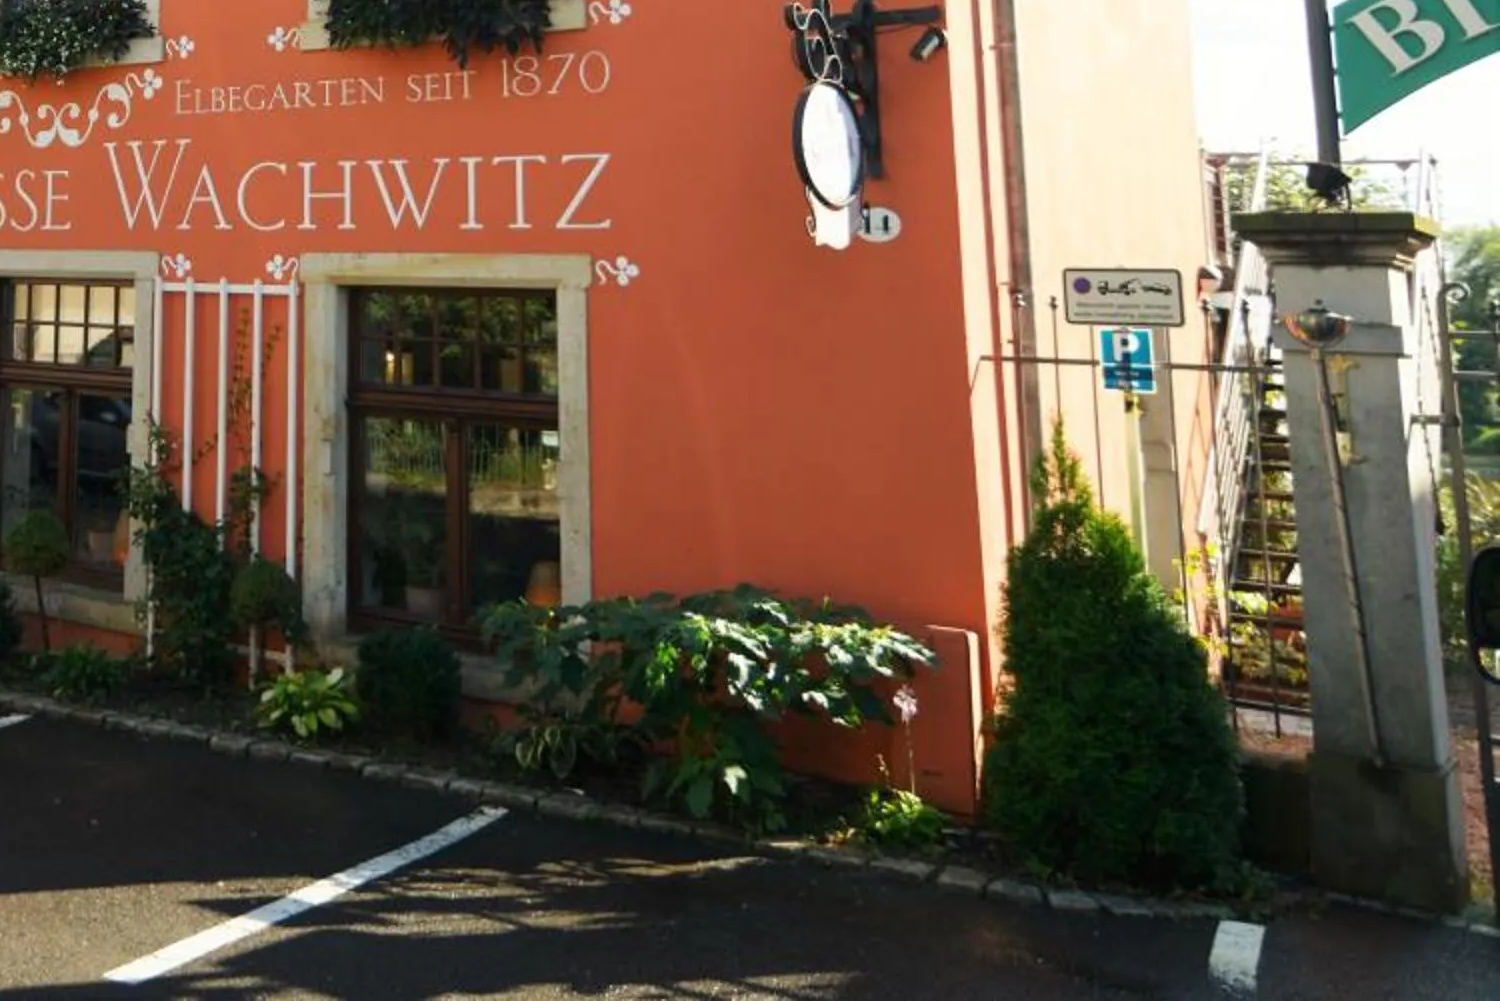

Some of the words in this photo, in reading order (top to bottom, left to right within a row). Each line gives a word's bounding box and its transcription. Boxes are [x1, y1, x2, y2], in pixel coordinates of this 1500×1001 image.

[406, 69, 477, 103] SEIT
[501, 51, 611, 99] 1870
[103, 138, 613, 231] WACHWITZ
[1112, 332, 1140, 361] P
